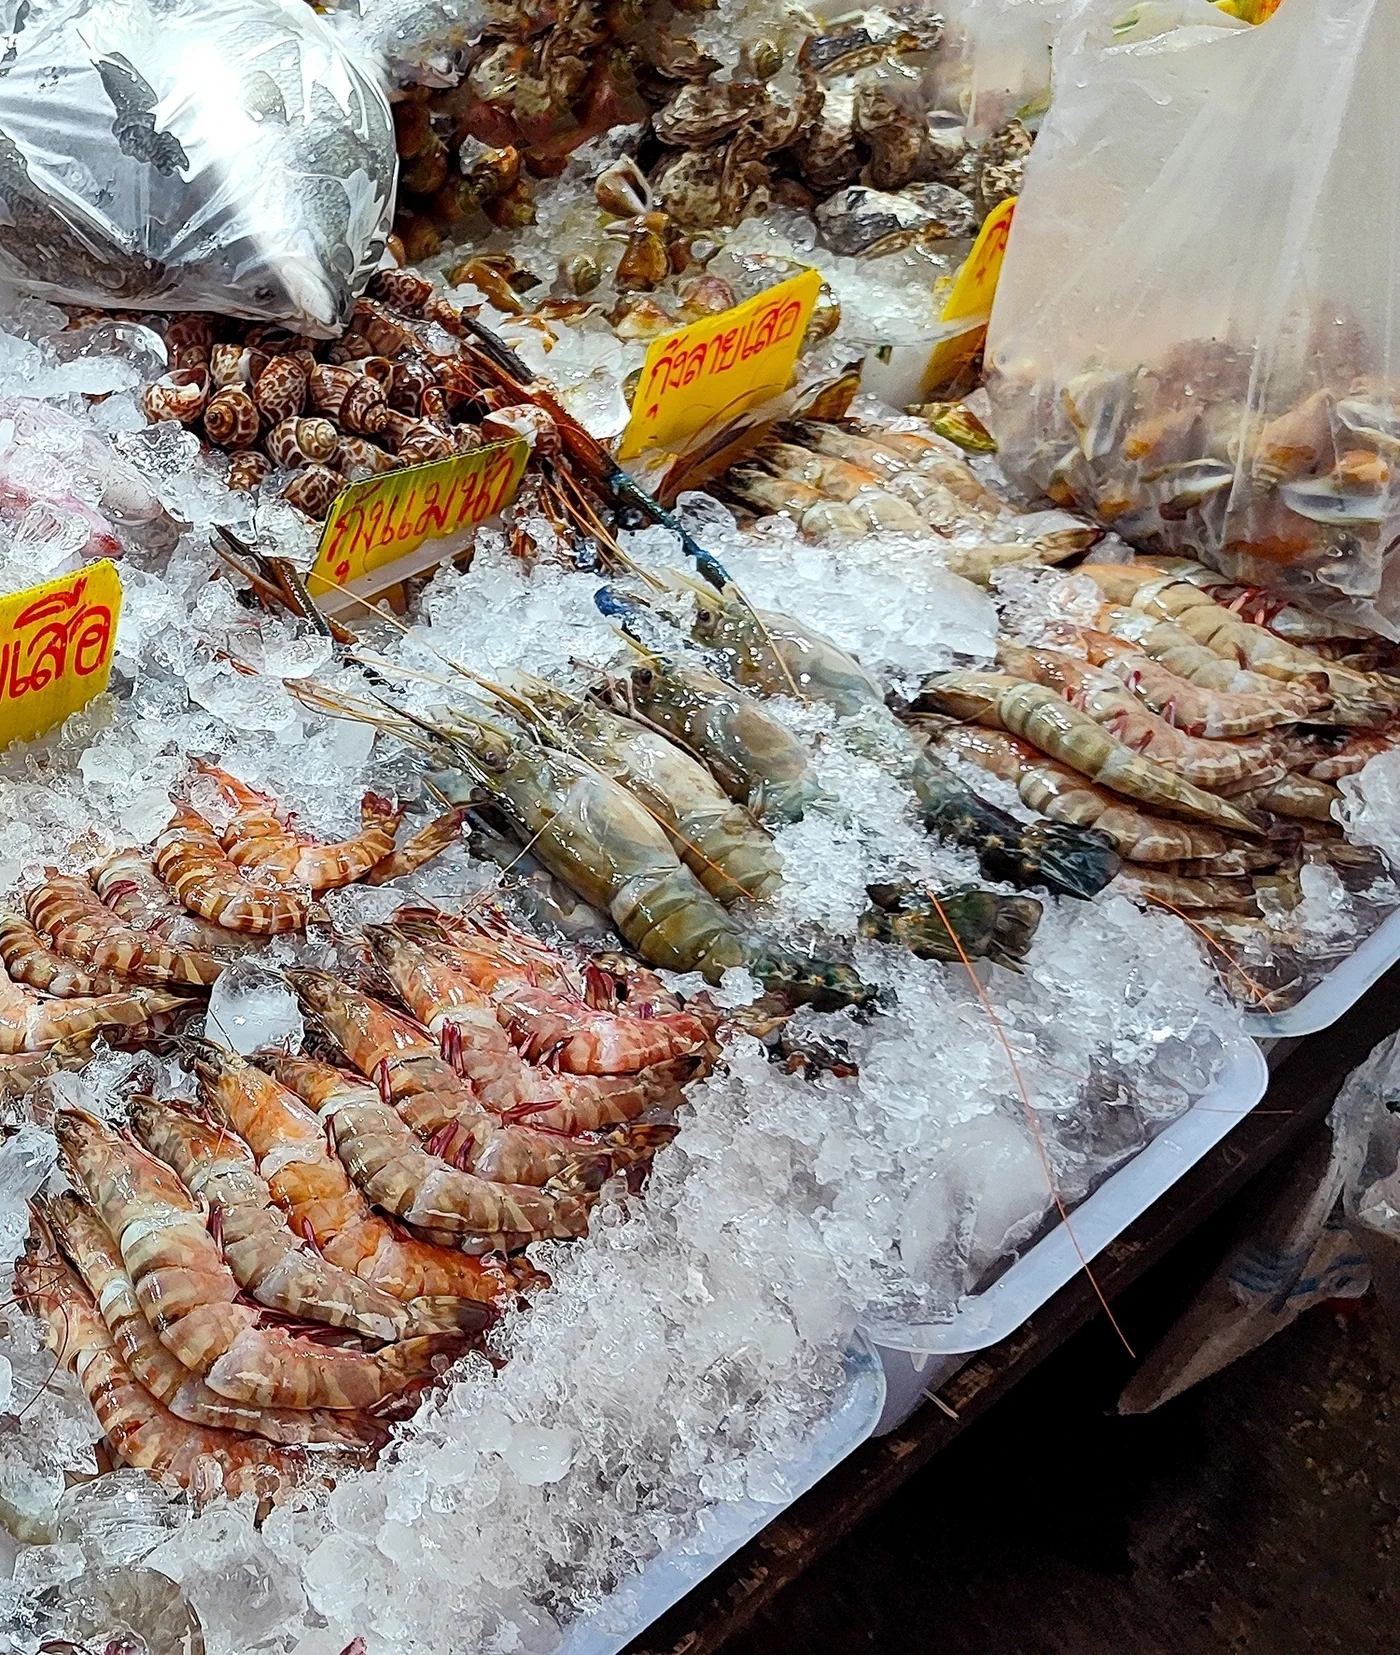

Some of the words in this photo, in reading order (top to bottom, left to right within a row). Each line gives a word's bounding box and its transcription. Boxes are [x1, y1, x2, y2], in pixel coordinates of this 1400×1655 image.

[644, 295, 802, 421] กุ้งลายเสือ
